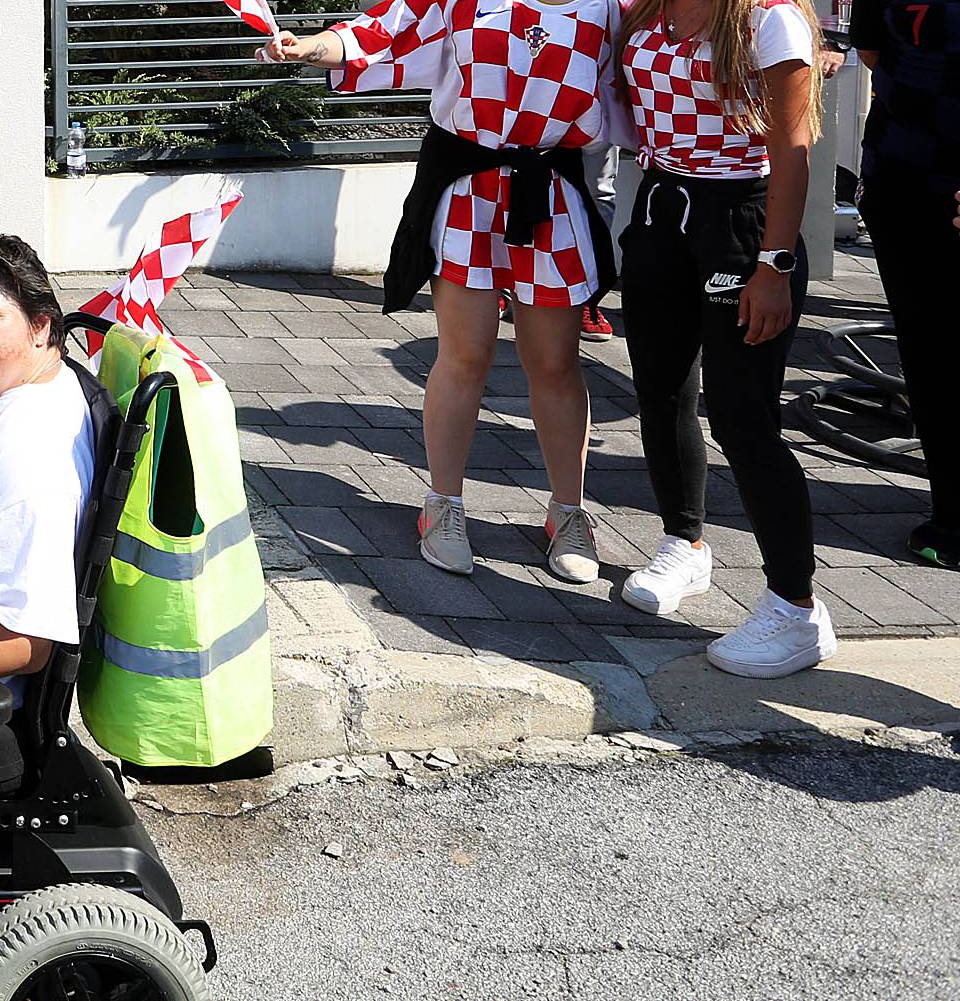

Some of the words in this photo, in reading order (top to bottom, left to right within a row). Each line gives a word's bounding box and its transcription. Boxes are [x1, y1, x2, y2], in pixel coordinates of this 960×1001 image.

[905, 4, 930, 46] 7
[709, 272, 742, 288] NIKE
[722, 297, 734, 305] DO
